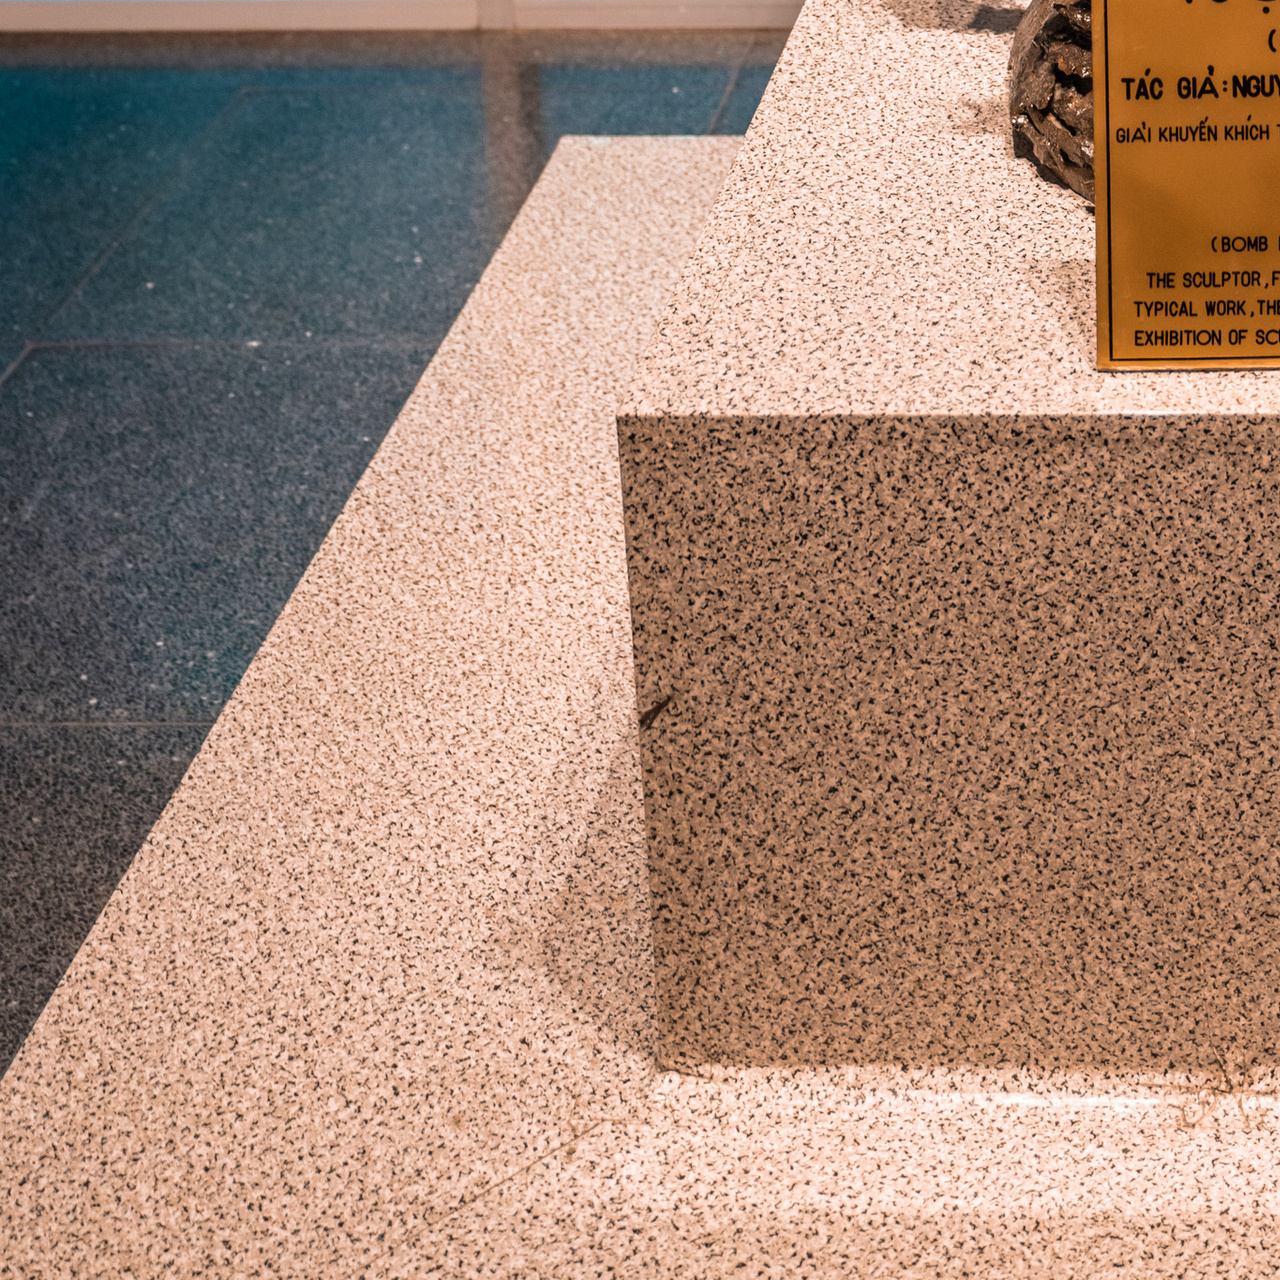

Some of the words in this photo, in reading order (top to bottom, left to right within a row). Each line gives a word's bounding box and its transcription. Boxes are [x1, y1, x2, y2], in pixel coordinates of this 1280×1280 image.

[1120, 67, 1164, 101] TÁC
[1115, 121, 1152, 144] GIẢI
[1223, 114, 1270, 142] KHÍCH
[1210, 235, 1269, 253] (BOMB
[1145, 271, 1176, 289] THE
[1133, 300, 1199, 318] TYPICAL
[1134, 329, 1222, 347] EXHIBITION
[1227, 328, 1249, 346] OF
